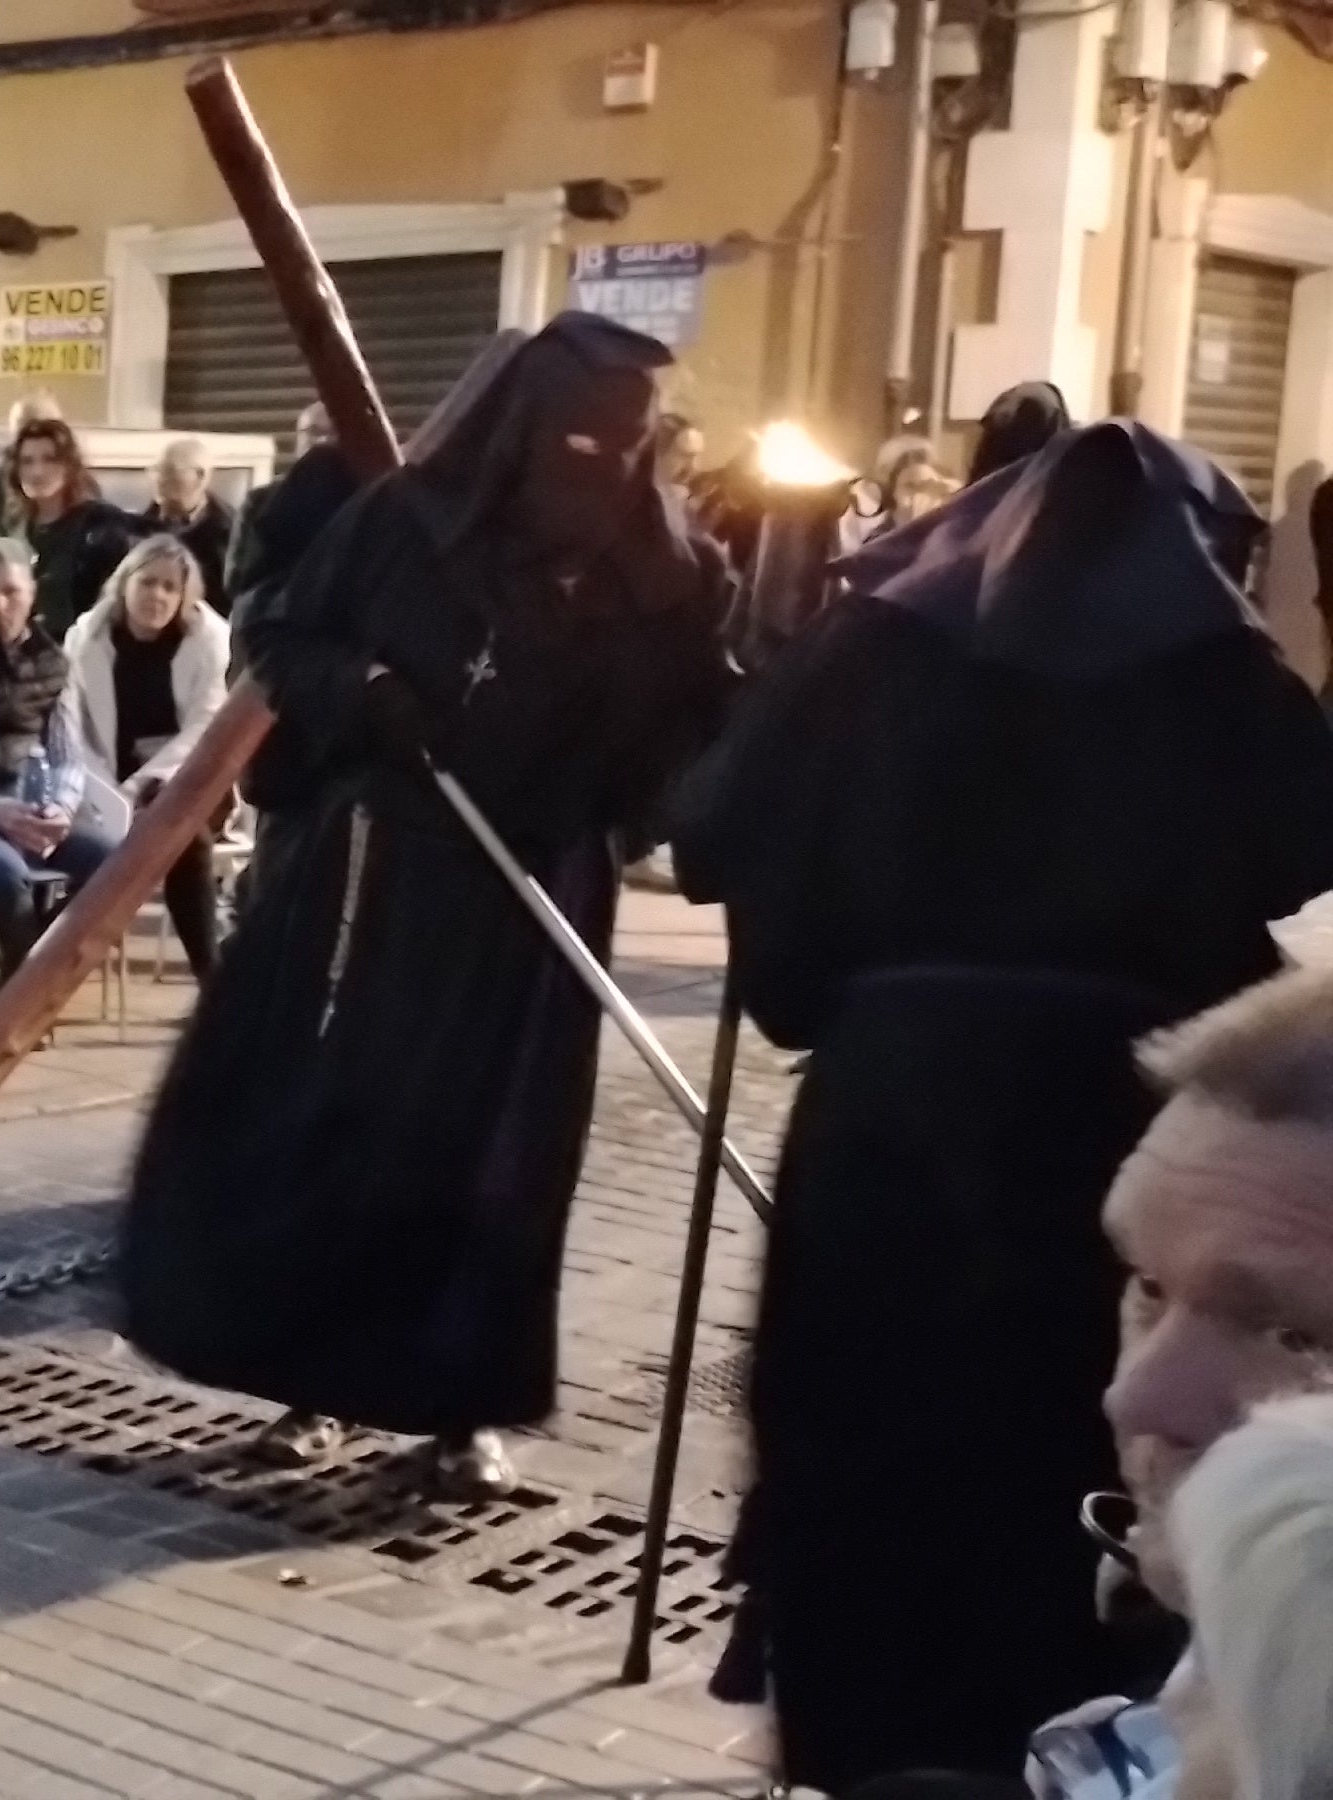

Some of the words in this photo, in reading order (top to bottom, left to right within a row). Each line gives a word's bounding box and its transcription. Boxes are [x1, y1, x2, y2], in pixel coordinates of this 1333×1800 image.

[617, 243, 696, 263] GRUPO
[5, 286, 106, 315] VENDE
[579, 280, 694, 314] VENDE
[1, 345, 20, 372] 96
[25, 344, 55, 371] 227
[61, 343, 79, 370] 10
[83, 343, 103, 370] 01
